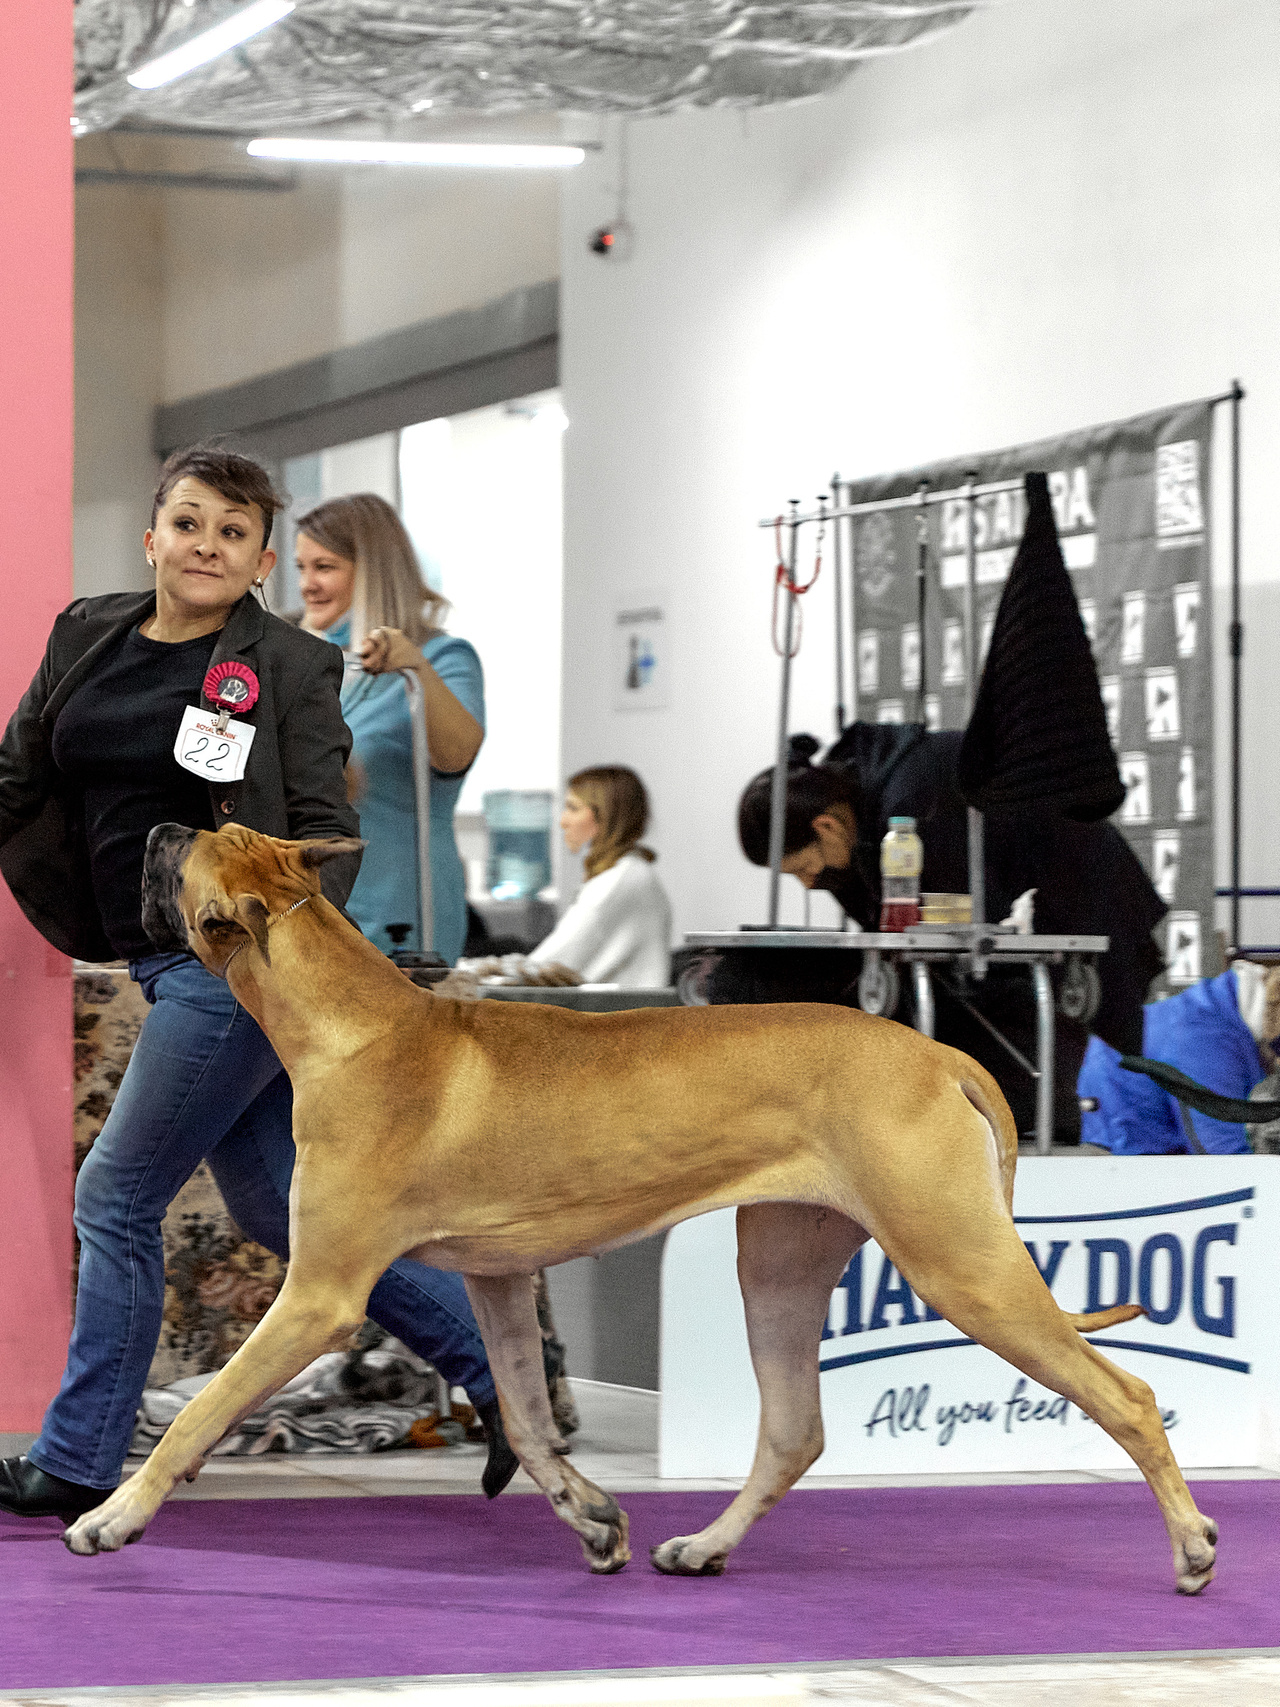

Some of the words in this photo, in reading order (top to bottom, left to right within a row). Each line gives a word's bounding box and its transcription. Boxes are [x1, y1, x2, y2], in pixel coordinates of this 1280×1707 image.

[184, 737, 230, 771] 22
[1083, 1222, 1238, 1339] DOG
[864, 1383, 931, 1438] All
[936, 1402, 999, 1446] you
